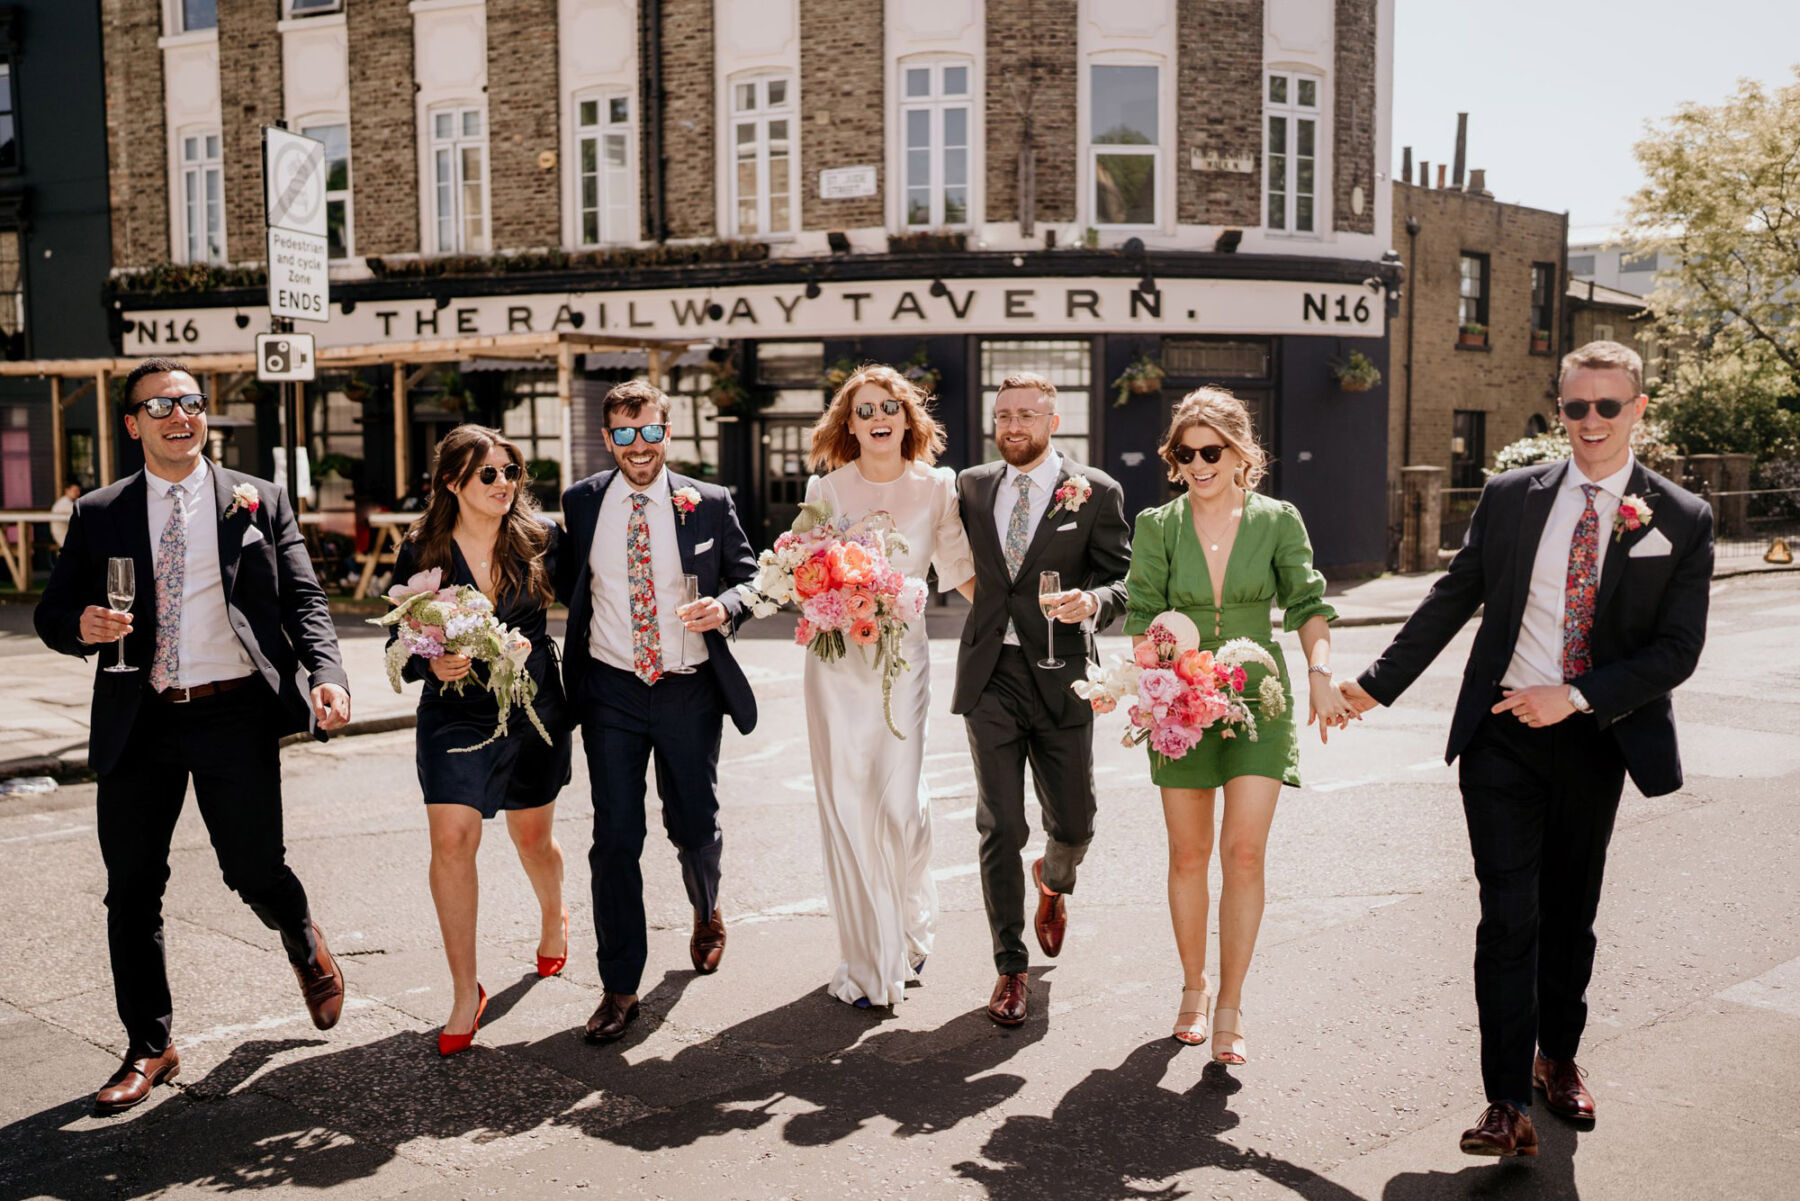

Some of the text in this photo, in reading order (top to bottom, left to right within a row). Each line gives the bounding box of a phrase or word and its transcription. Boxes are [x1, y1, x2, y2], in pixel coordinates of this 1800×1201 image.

[274, 234, 324, 253] Pedestrian
[277, 253, 321, 270] and cycle
[288, 270, 311, 285] Zone
[279, 290, 322, 312] ENDS
[1303, 293, 1370, 322] N16
[376, 308, 478, 336] THE
[508, 295, 802, 331] RAILWAY
[137, 319, 198, 343] N16
